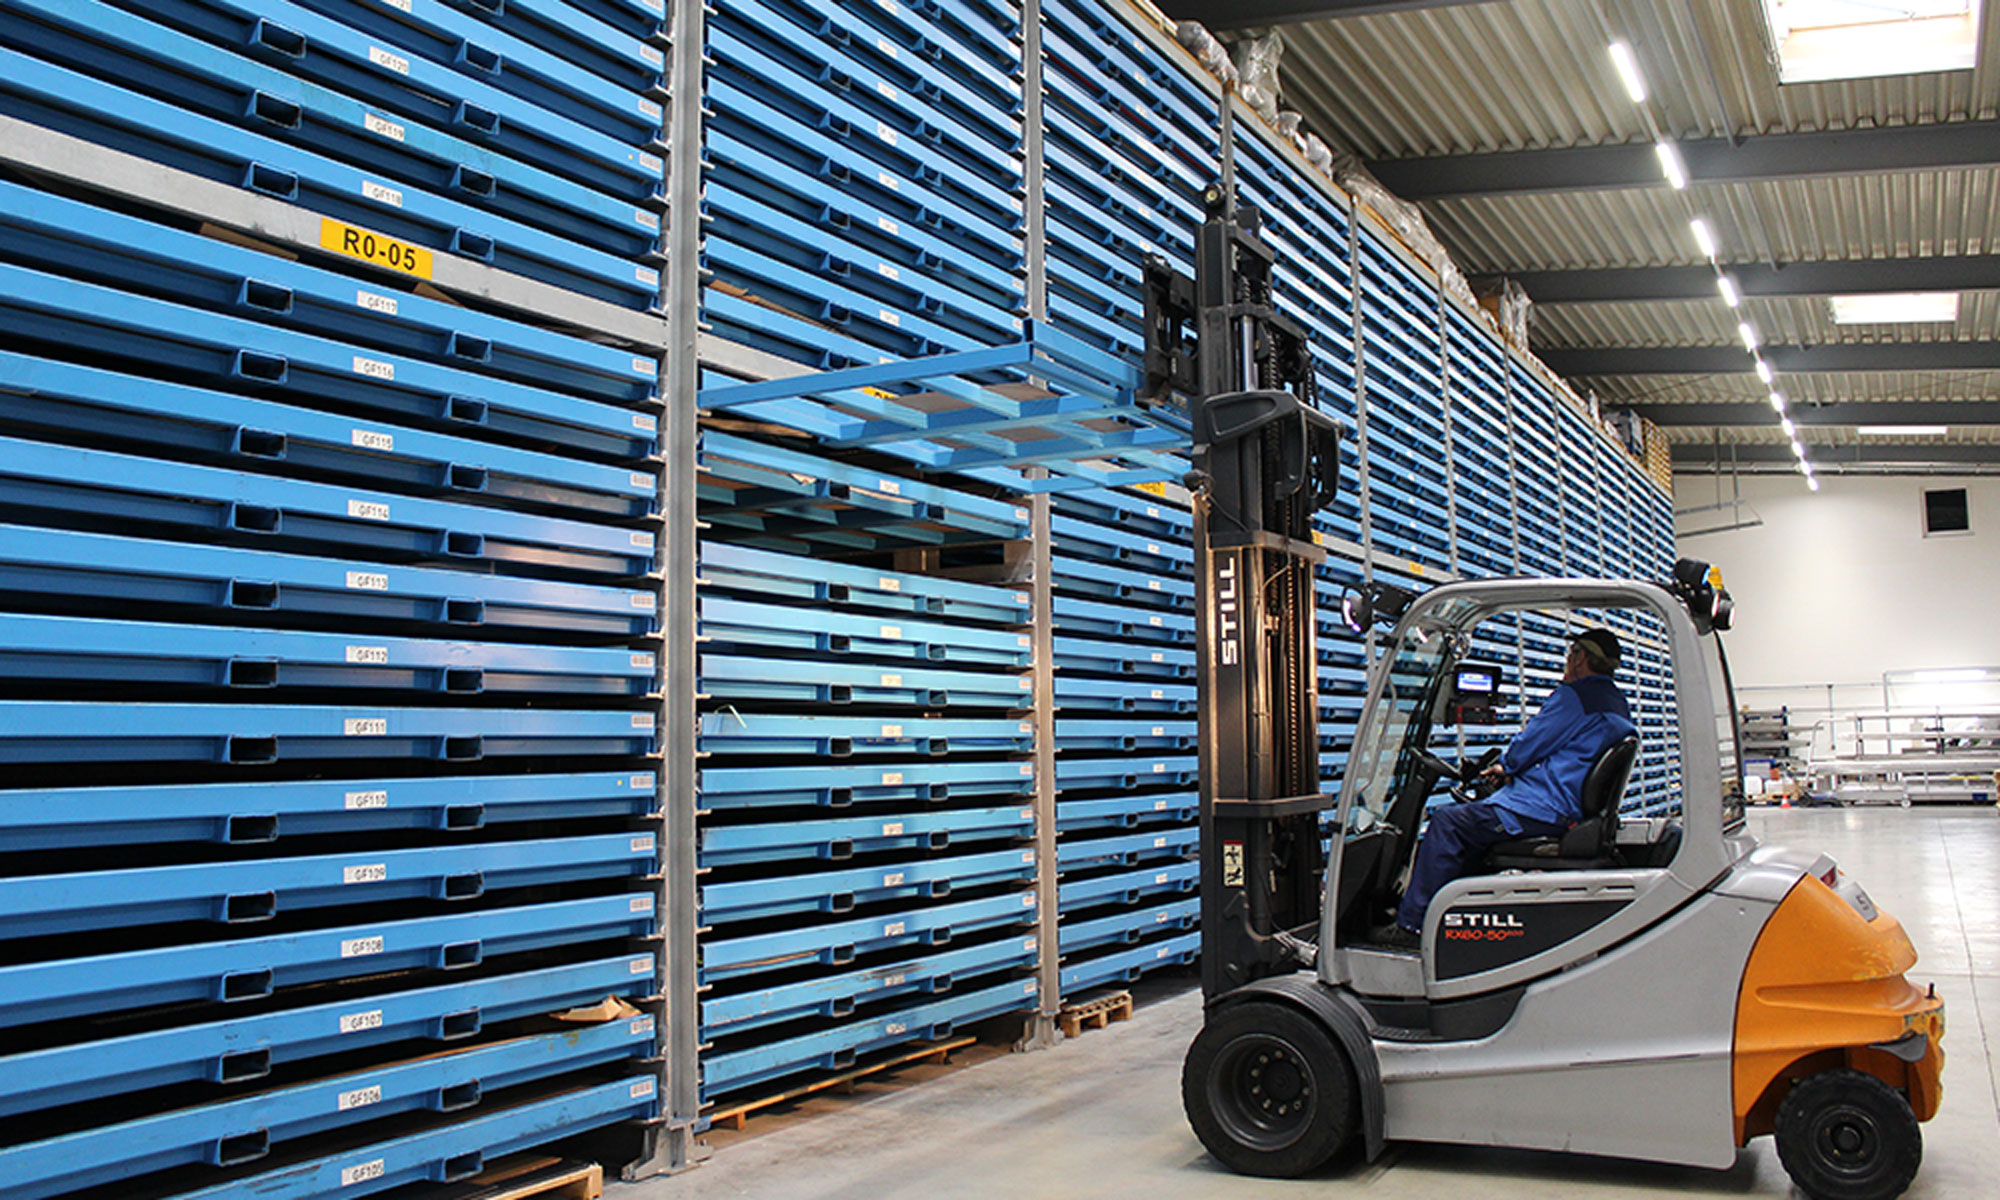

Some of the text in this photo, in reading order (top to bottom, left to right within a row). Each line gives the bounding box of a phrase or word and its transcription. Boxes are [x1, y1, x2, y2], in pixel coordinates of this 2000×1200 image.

[344, 228, 416, 270] R0-05
[1219, 557, 1238, 665] STILL
[355, 722, 385, 734] GF111
[1444, 913, 1524, 927] STILL
